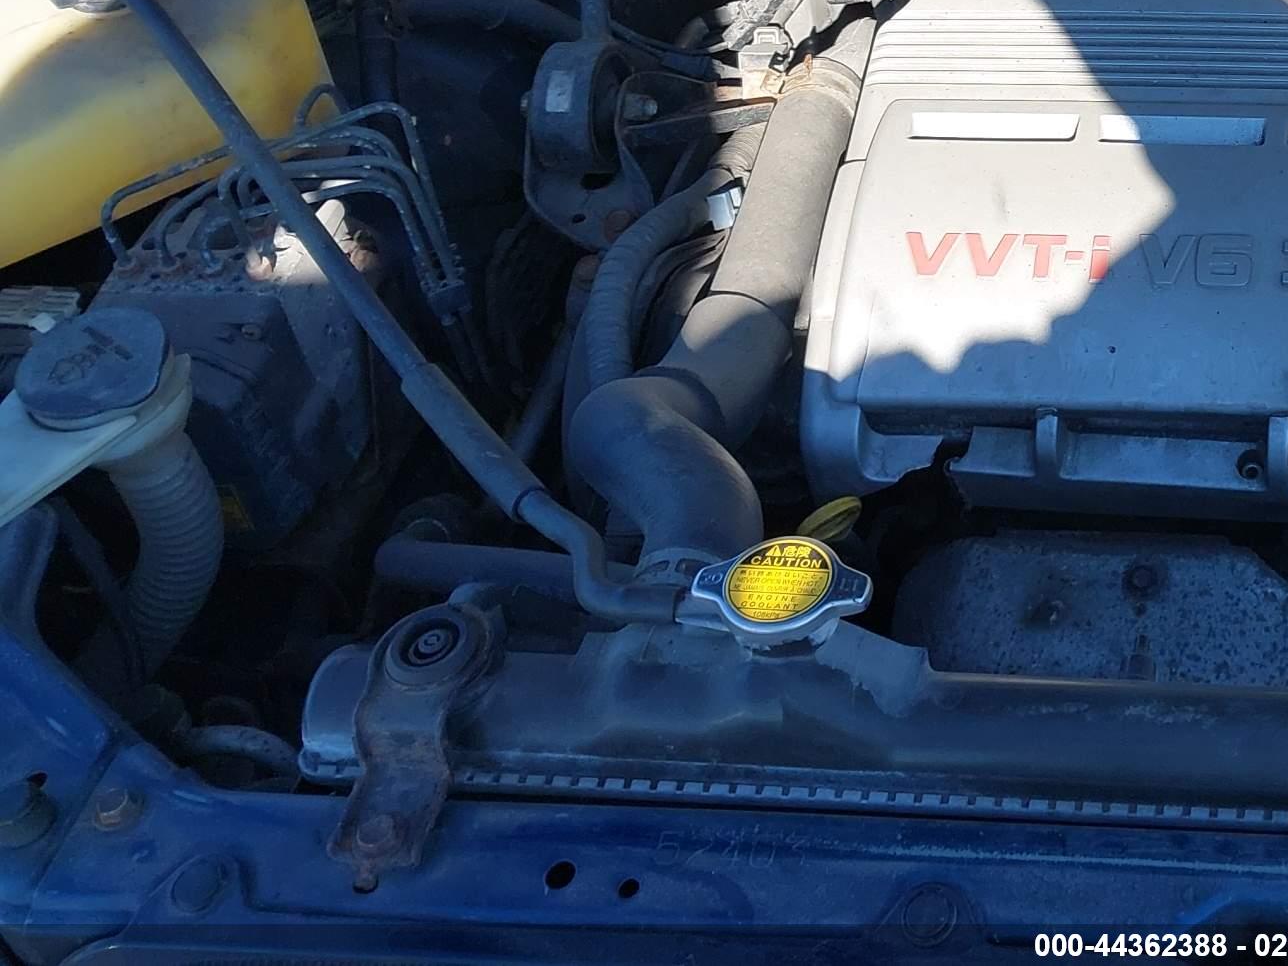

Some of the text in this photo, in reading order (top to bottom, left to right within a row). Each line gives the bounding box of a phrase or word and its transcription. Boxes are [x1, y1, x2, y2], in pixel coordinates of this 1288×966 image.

[905, 231, 1112, 284] VVT-i
[1139, 233, 1254, 288] V6
[750, 555, 822, 569] CAUTION
[747, 594, 798, 603] ENGINE
[740, 600, 799, 610] COOLANT
